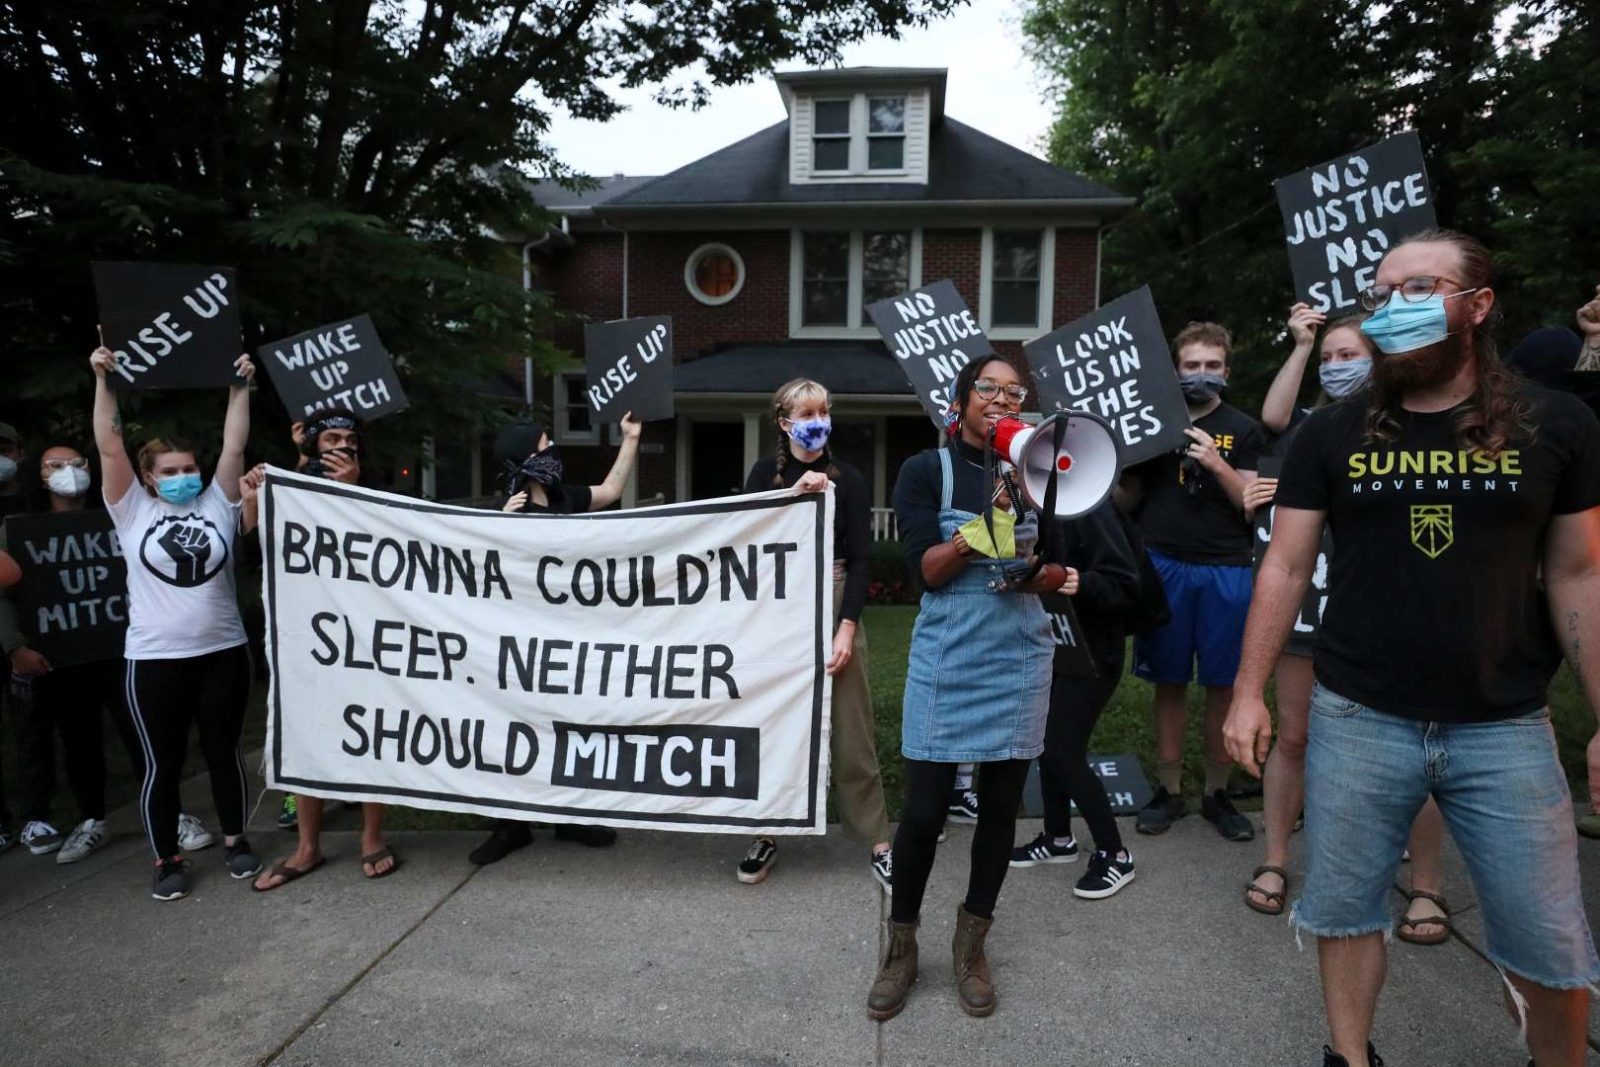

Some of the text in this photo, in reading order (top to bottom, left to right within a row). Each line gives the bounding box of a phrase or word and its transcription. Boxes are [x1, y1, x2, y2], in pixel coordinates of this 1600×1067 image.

[1311, 155, 1369, 198] NO
[1286, 172, 1427, 245] JUSTICE
[1326, 228, 1388, 273] NO
[894, 292, 935, 323] NO
[1308, 266, 1376, 313] SLE
[112, 273, 229, 383] RISE UP
[274, 323, 362, 371] WAKE
[893, 309, 982, 359] JUSTICE
[1056, 315, 1134, 367] LOOK
[310, 360, 349, 391] UP
[588, 323, 667, 412] RISE UP
[928, 348, 970, 383] NO
[1064, 345, 1141, 396] US IN
[1072, 379, 1142, 417] THE
[1348, 450, 1522, 478] SUNRISE
[1353, 479, 1518, 494] MOVEMENT
[59, 565, 109, 595] UP
[282, 521, 797, 607] BREONNA COULD'NT
[38, 593, 131, 634] MITC
[310, 611, 741, 700] SLEEP. NEITHER
[341, 704, 737, 789] SHOULD MITCH
